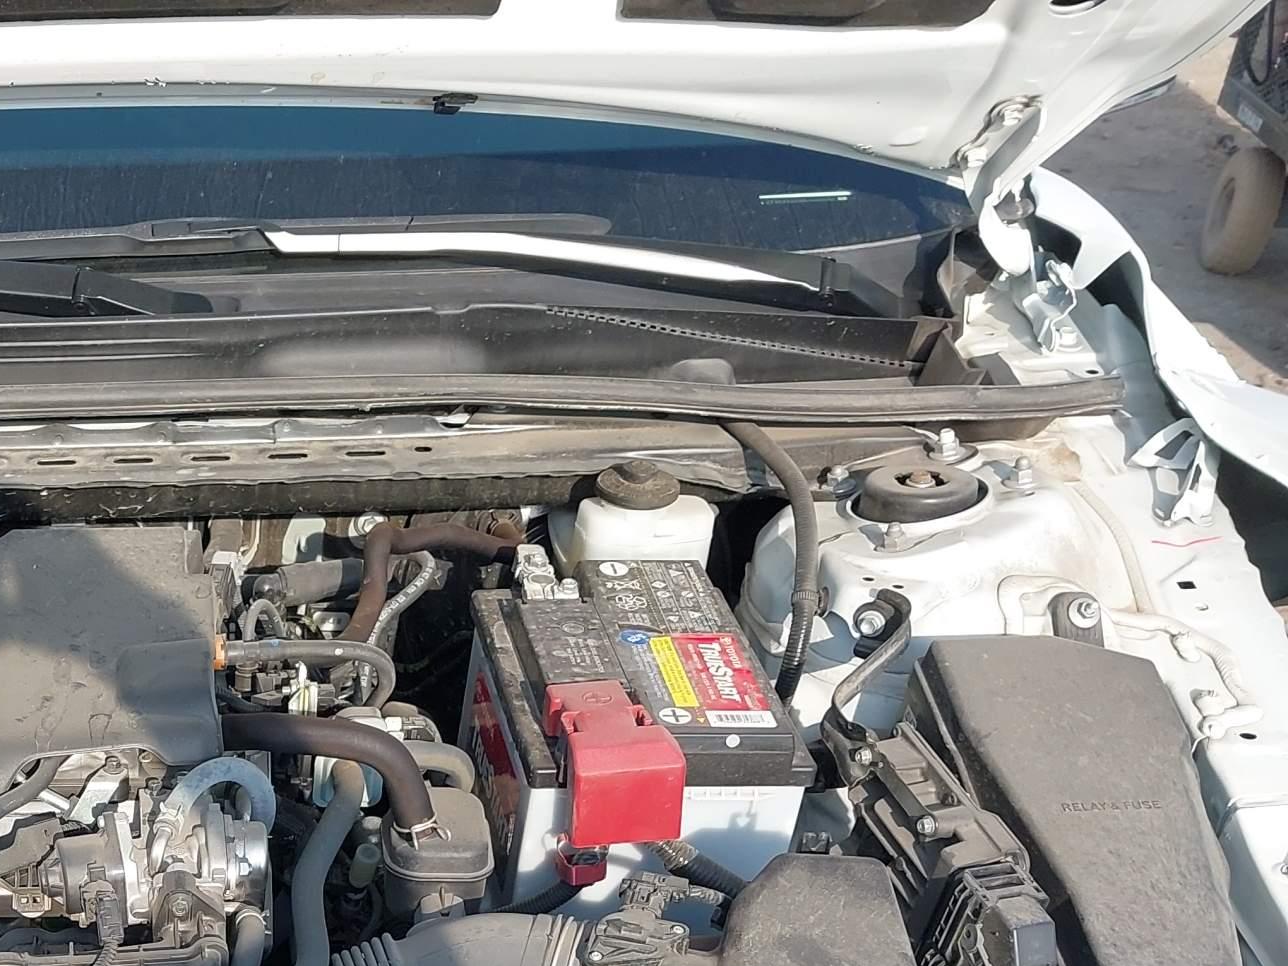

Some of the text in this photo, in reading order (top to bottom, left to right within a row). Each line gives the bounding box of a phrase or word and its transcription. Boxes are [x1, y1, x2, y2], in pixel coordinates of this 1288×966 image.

[725, 645, 743, 668] TOYOTA
[1061, 802, 1107, 812] RELAY
[1122, 800, 1163, 810] FUSE
